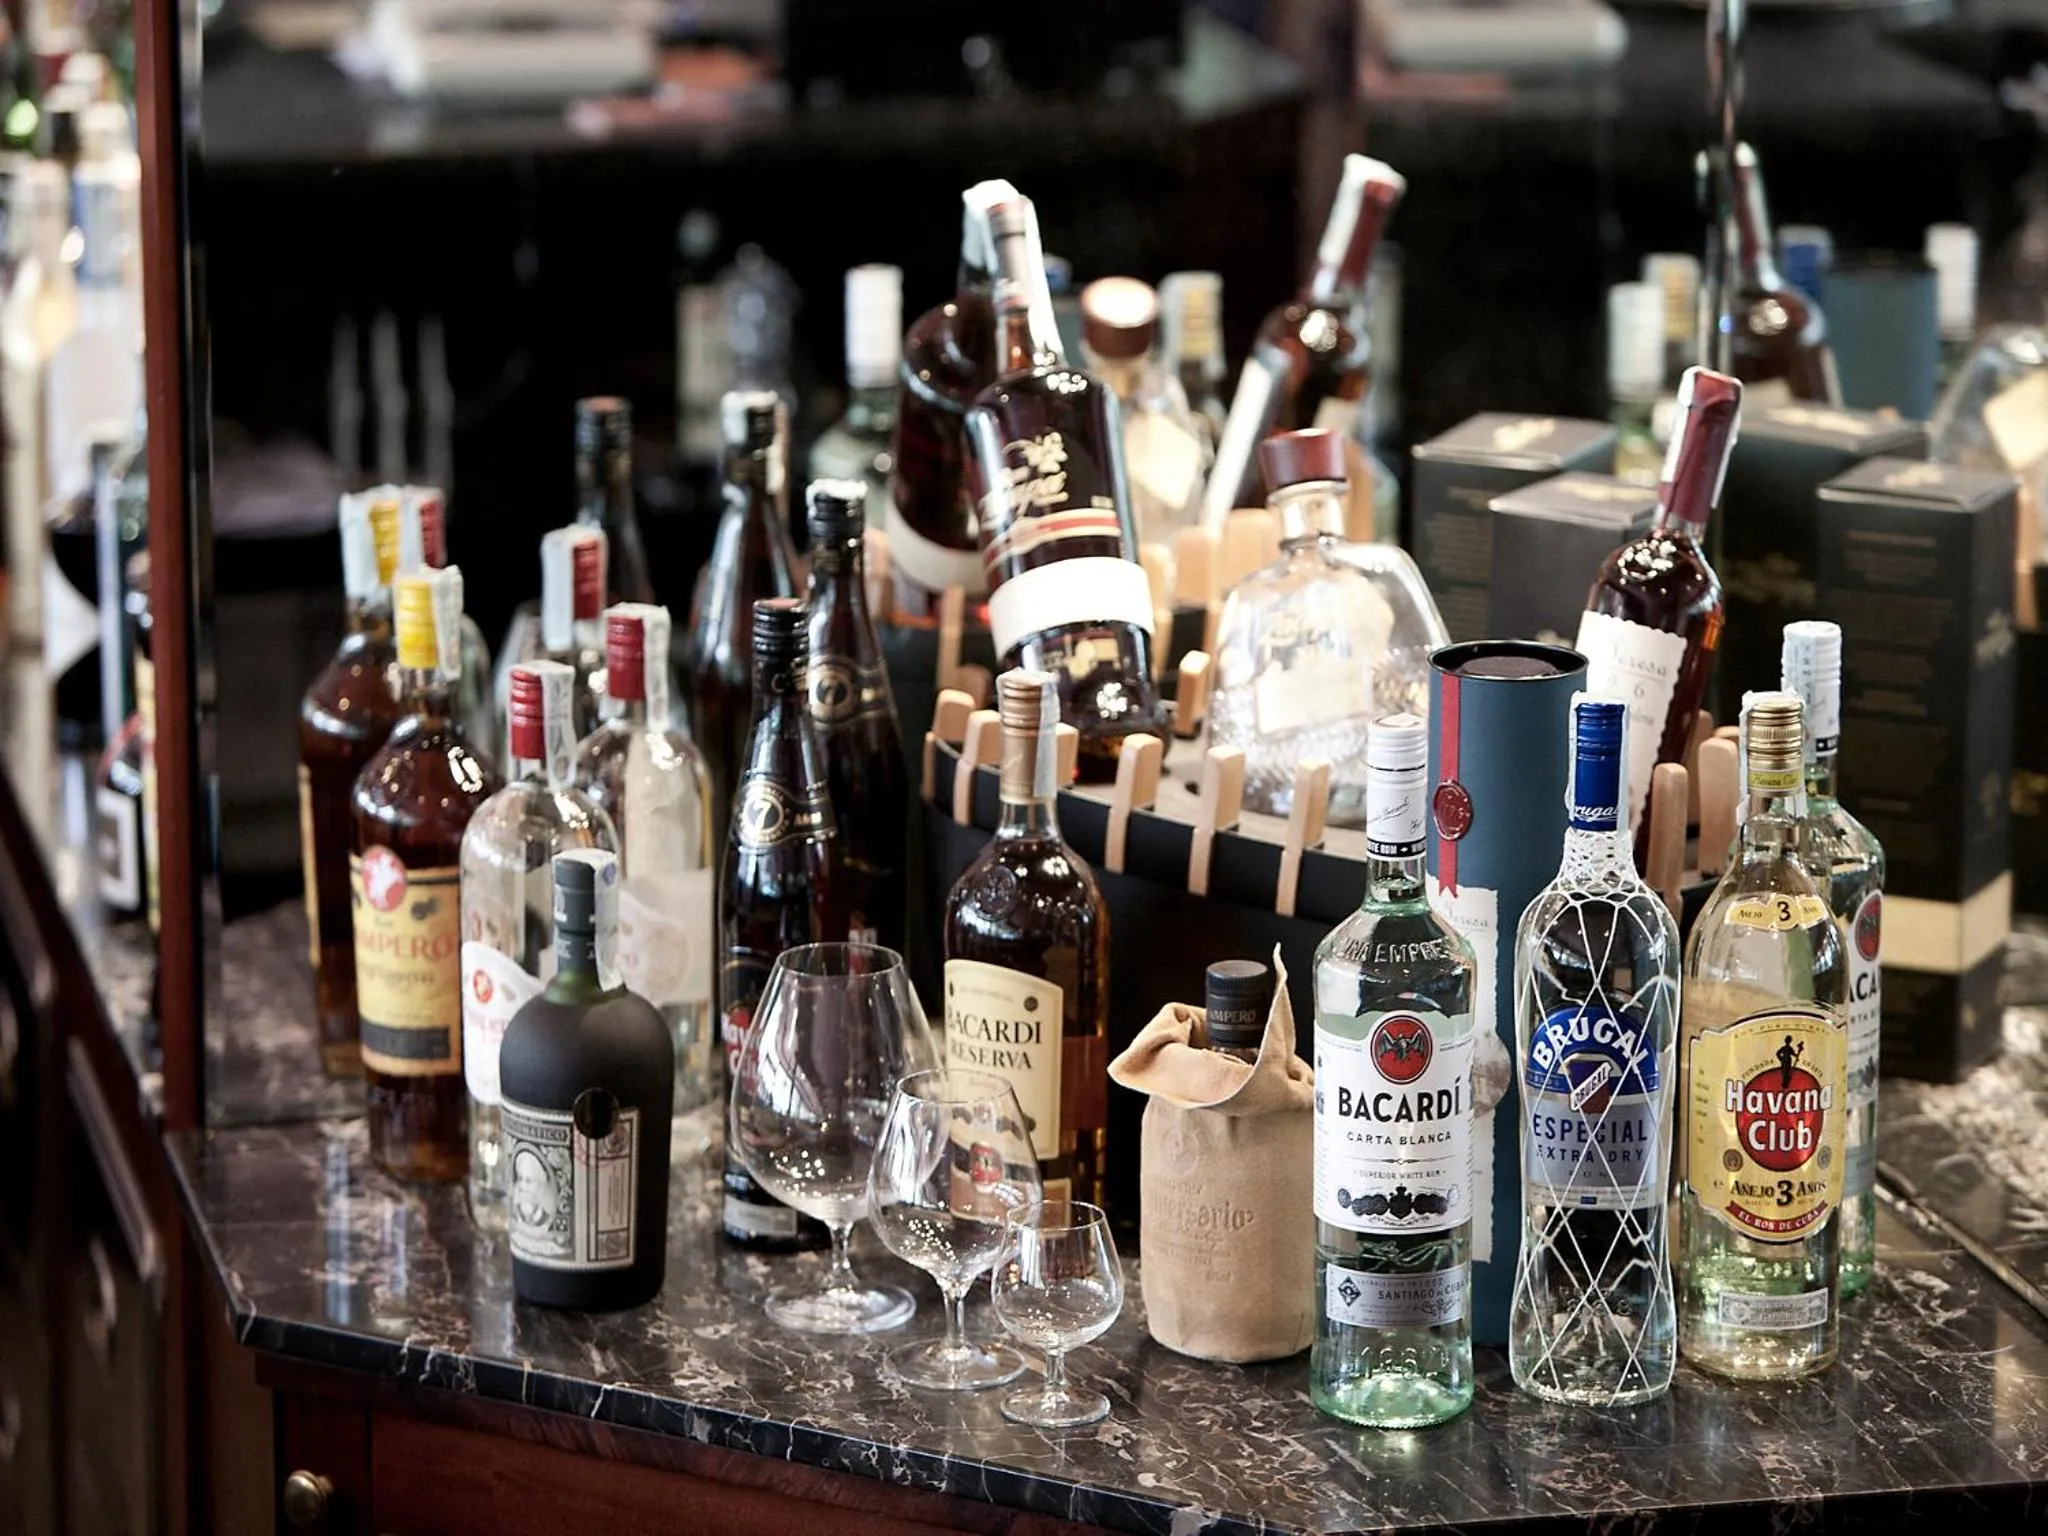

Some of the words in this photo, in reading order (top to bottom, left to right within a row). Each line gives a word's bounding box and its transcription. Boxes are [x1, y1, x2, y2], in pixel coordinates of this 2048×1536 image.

[1575, 805, 1619, 822] rugal
[1776, 901, 1791, 922] 3
[948, 1006, 1043, 1045] ACARDI
[1532, 1016, 1649, 1075] BRUGAL
[1338, 1075, 1462, 1123] BACARDÍ
[1726, 1078, 1833, 1115] Havana
[1347, 1131, 1393, 1146] CARTA
[1399, 1130, 1452, 1146] BLANCA
[1532, 1113, 1648, 1144] ESPECIAL
[1748, 1116, 1813, 1152] Club
[1536, 1144, 1595, 1164] EXTRA
[1608, 1147, 1644, 1163] DRY
[1775, 1179, 1794, 1207] 3
[1755, 1217, 1775, 1231] RON
[1377, 1289, 1435, 1301] SANTIAGO
